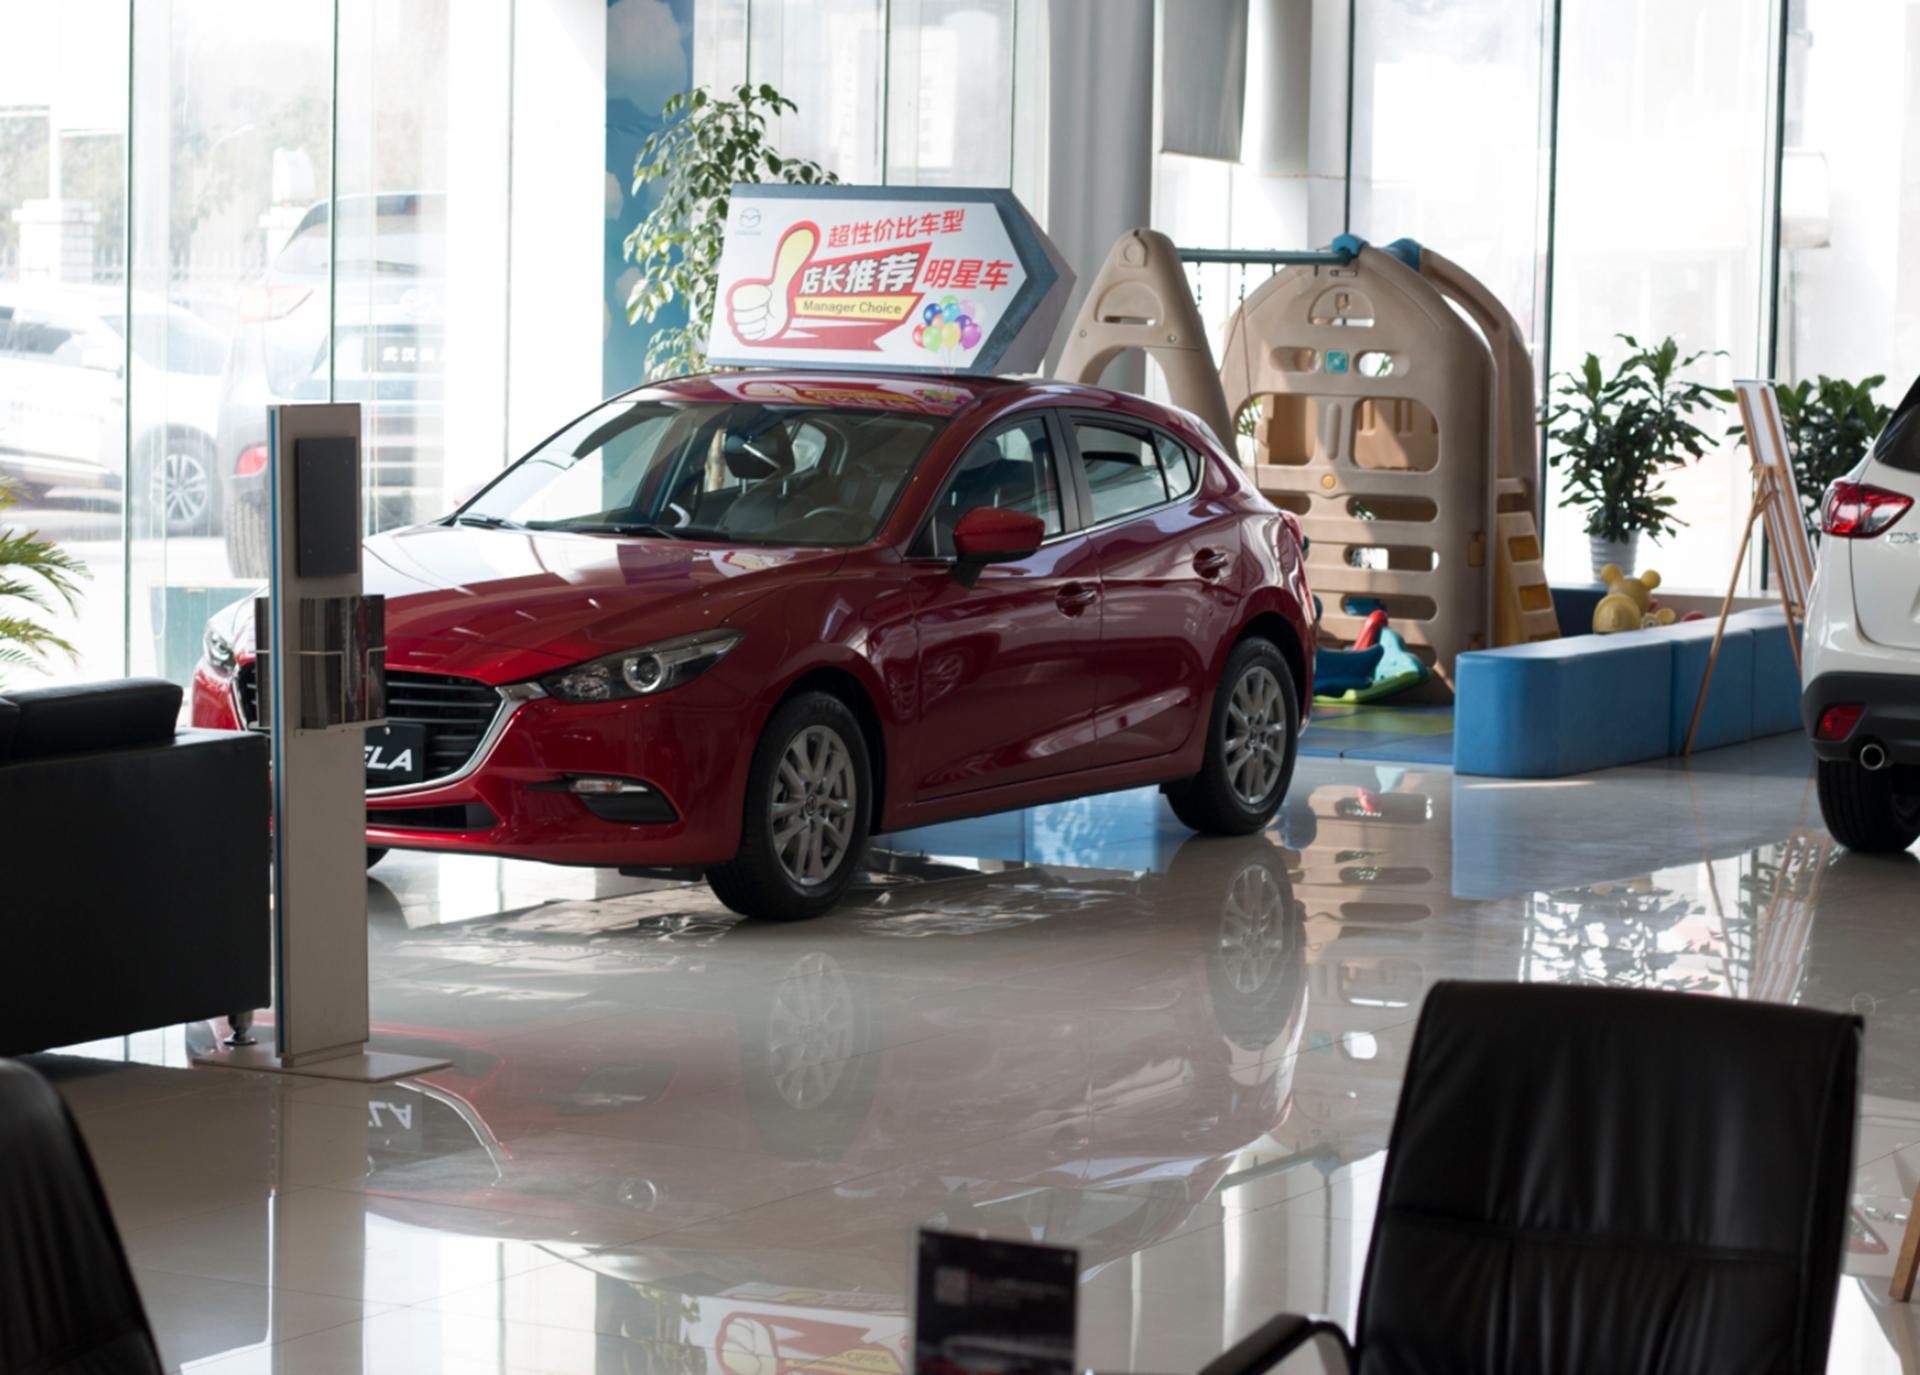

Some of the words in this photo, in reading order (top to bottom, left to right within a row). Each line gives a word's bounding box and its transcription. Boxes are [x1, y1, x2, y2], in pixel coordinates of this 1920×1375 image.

[828, 209, 965, 248] 超性价比车型
[800, 252, 921, 294] 店长推荐
[923, 260, 1013, 291] 明星车
[802, 300, 856, 316] Manager
[859, 302, 903, 315] Choice
